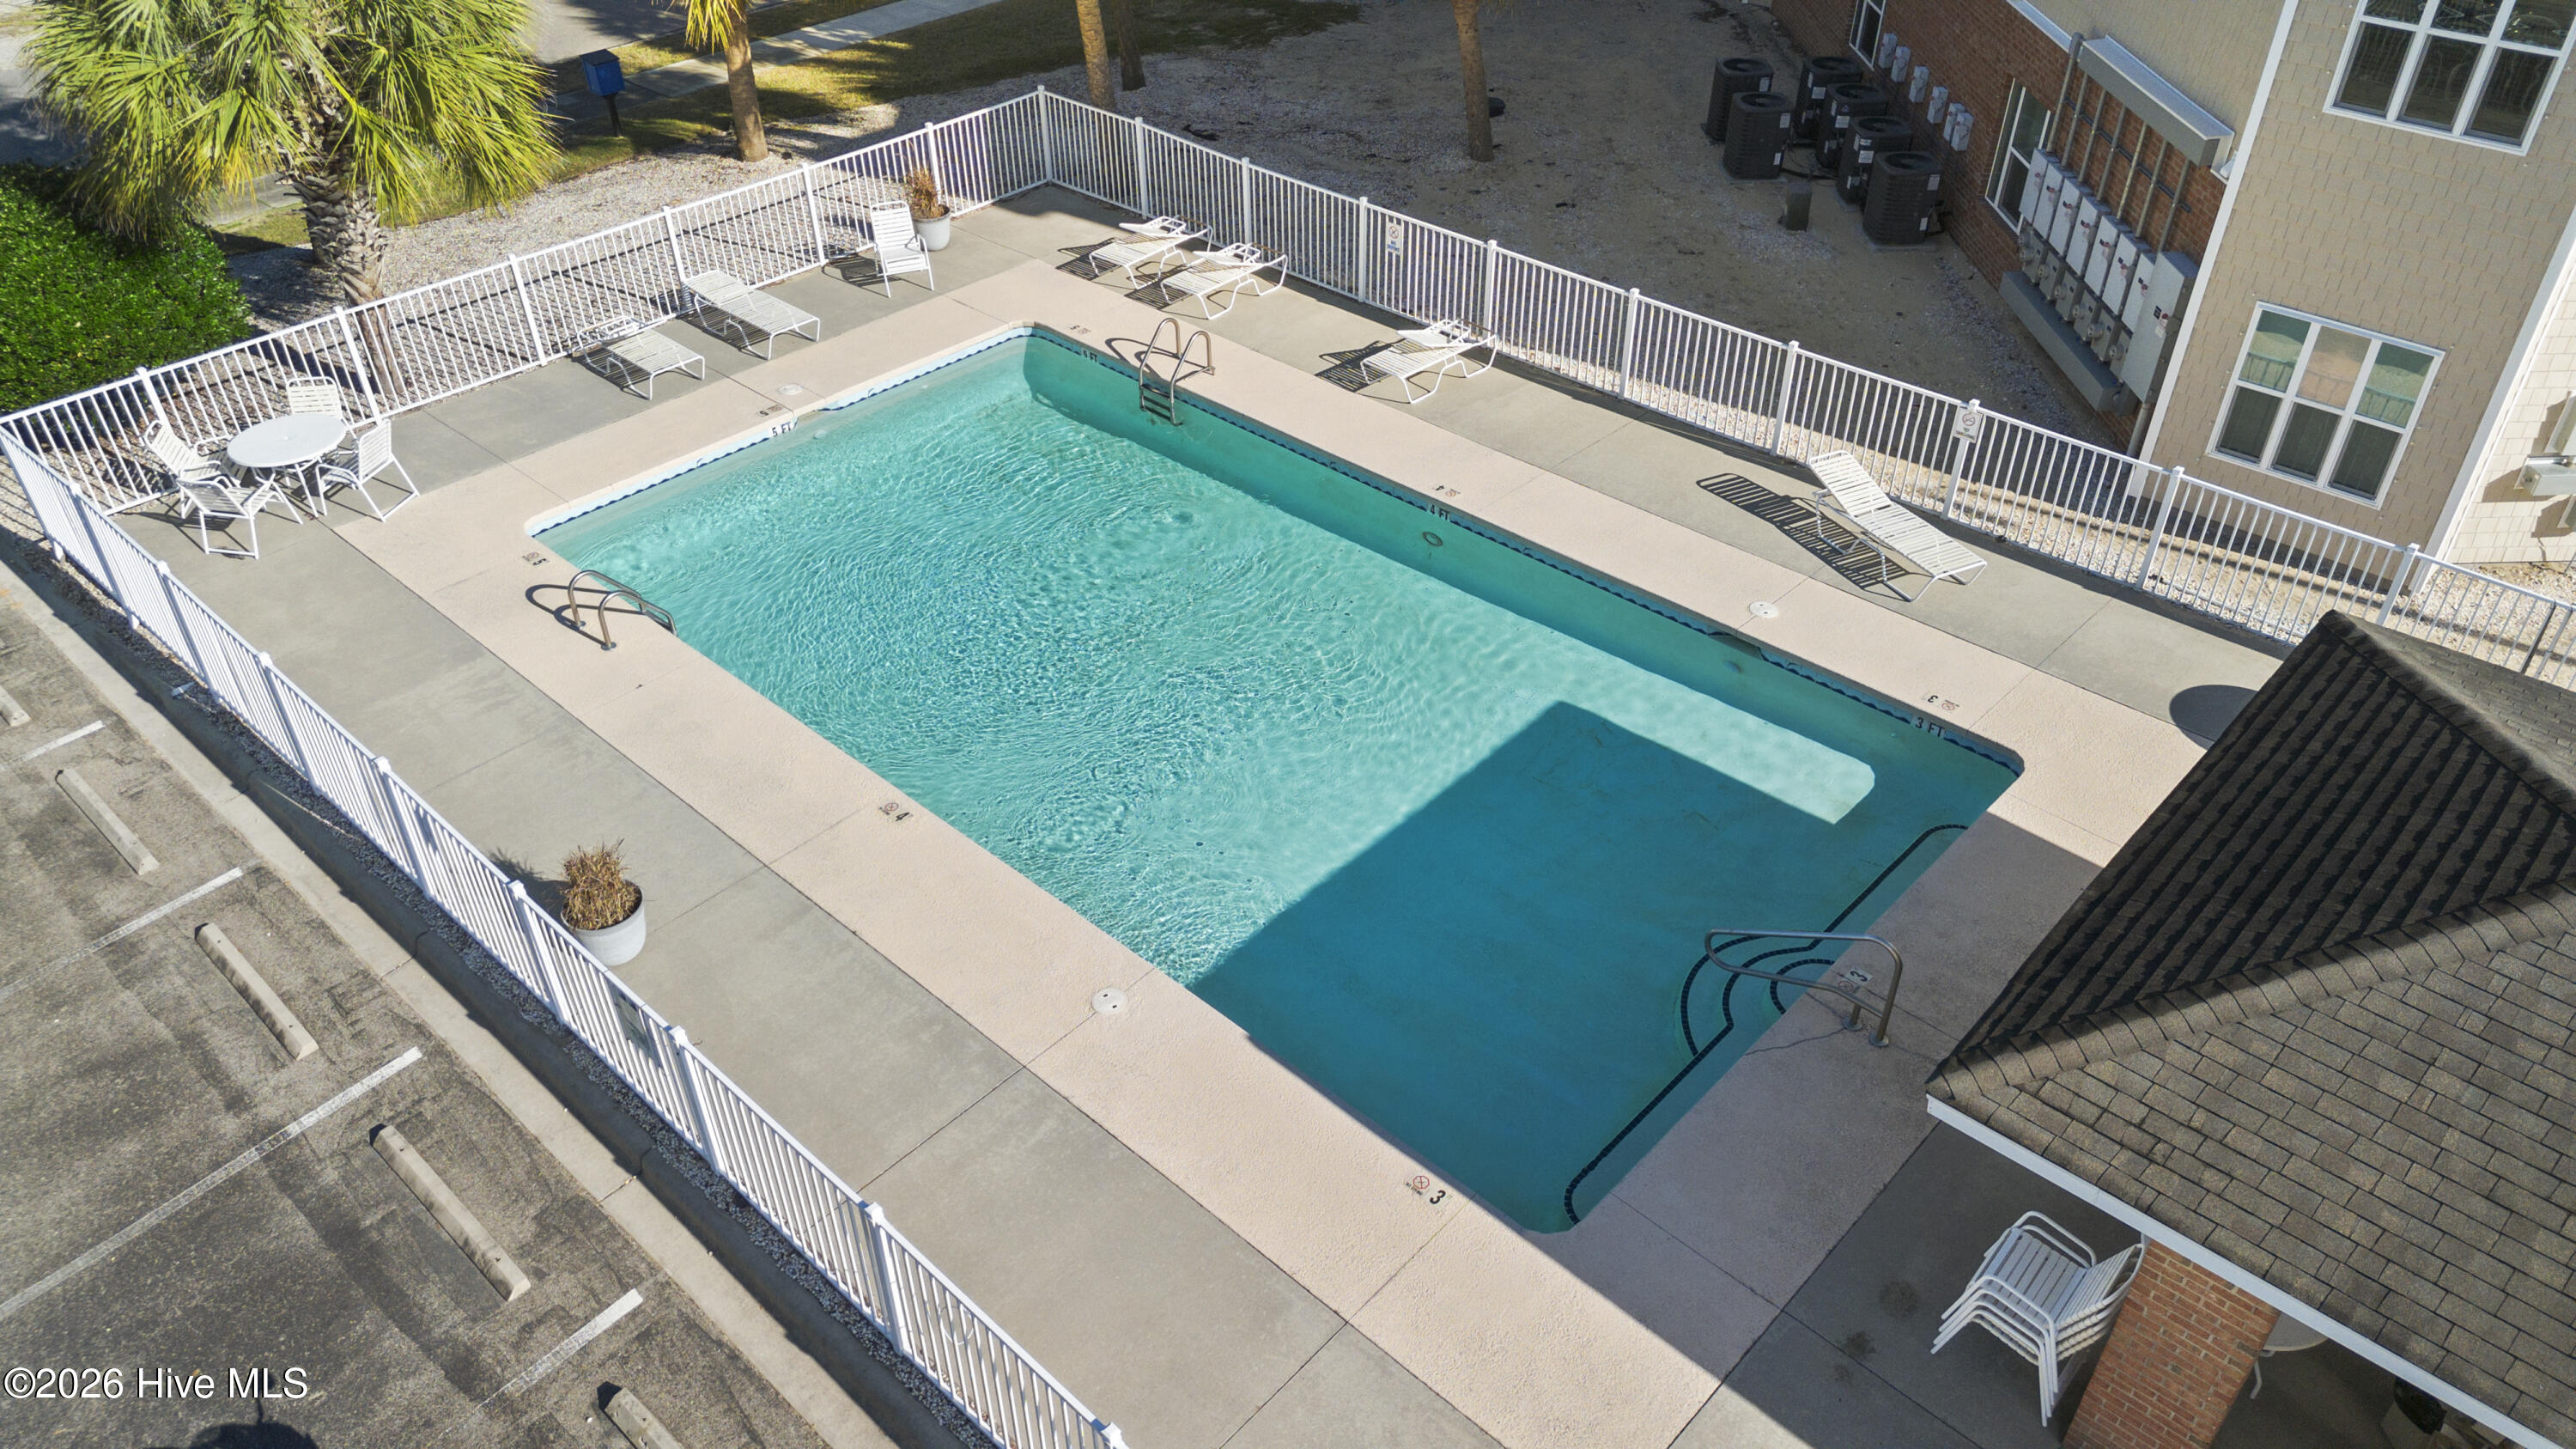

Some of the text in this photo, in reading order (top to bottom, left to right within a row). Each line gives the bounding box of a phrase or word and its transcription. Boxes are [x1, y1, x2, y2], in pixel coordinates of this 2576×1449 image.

[772, 421, 791, 437] 5 FT
[1430, 504, 1449, 521] 4 FT
[1927, 695, 1939, 703] 3
[1916, 716, 1946, 738] 3 FT
[896, 812, 910, 822] 4
[1850, 971, 1868, 983] 3
[1429, 1190, 1447, 1204] 3
